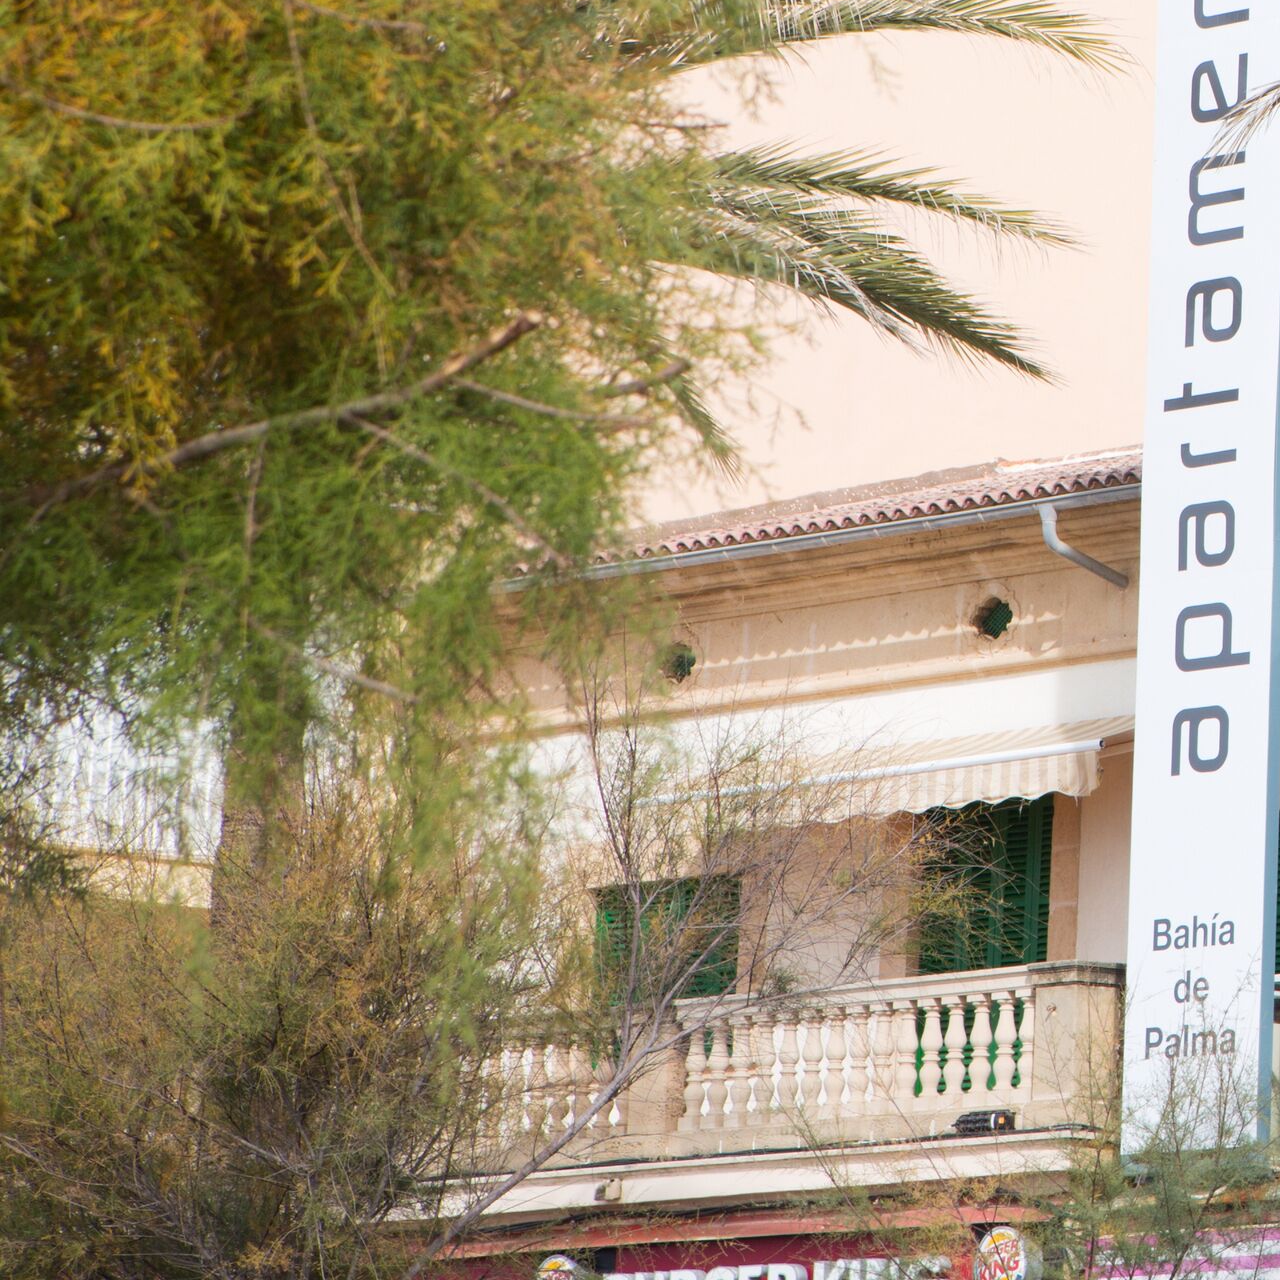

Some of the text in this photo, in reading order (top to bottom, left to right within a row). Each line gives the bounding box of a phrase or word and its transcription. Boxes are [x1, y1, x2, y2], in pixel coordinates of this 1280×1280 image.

[1152, 912, 1236, 952] Bahía
[1173, 970, 1210, 1004] de
[1144, 1024, 1237, 1060] Palma
